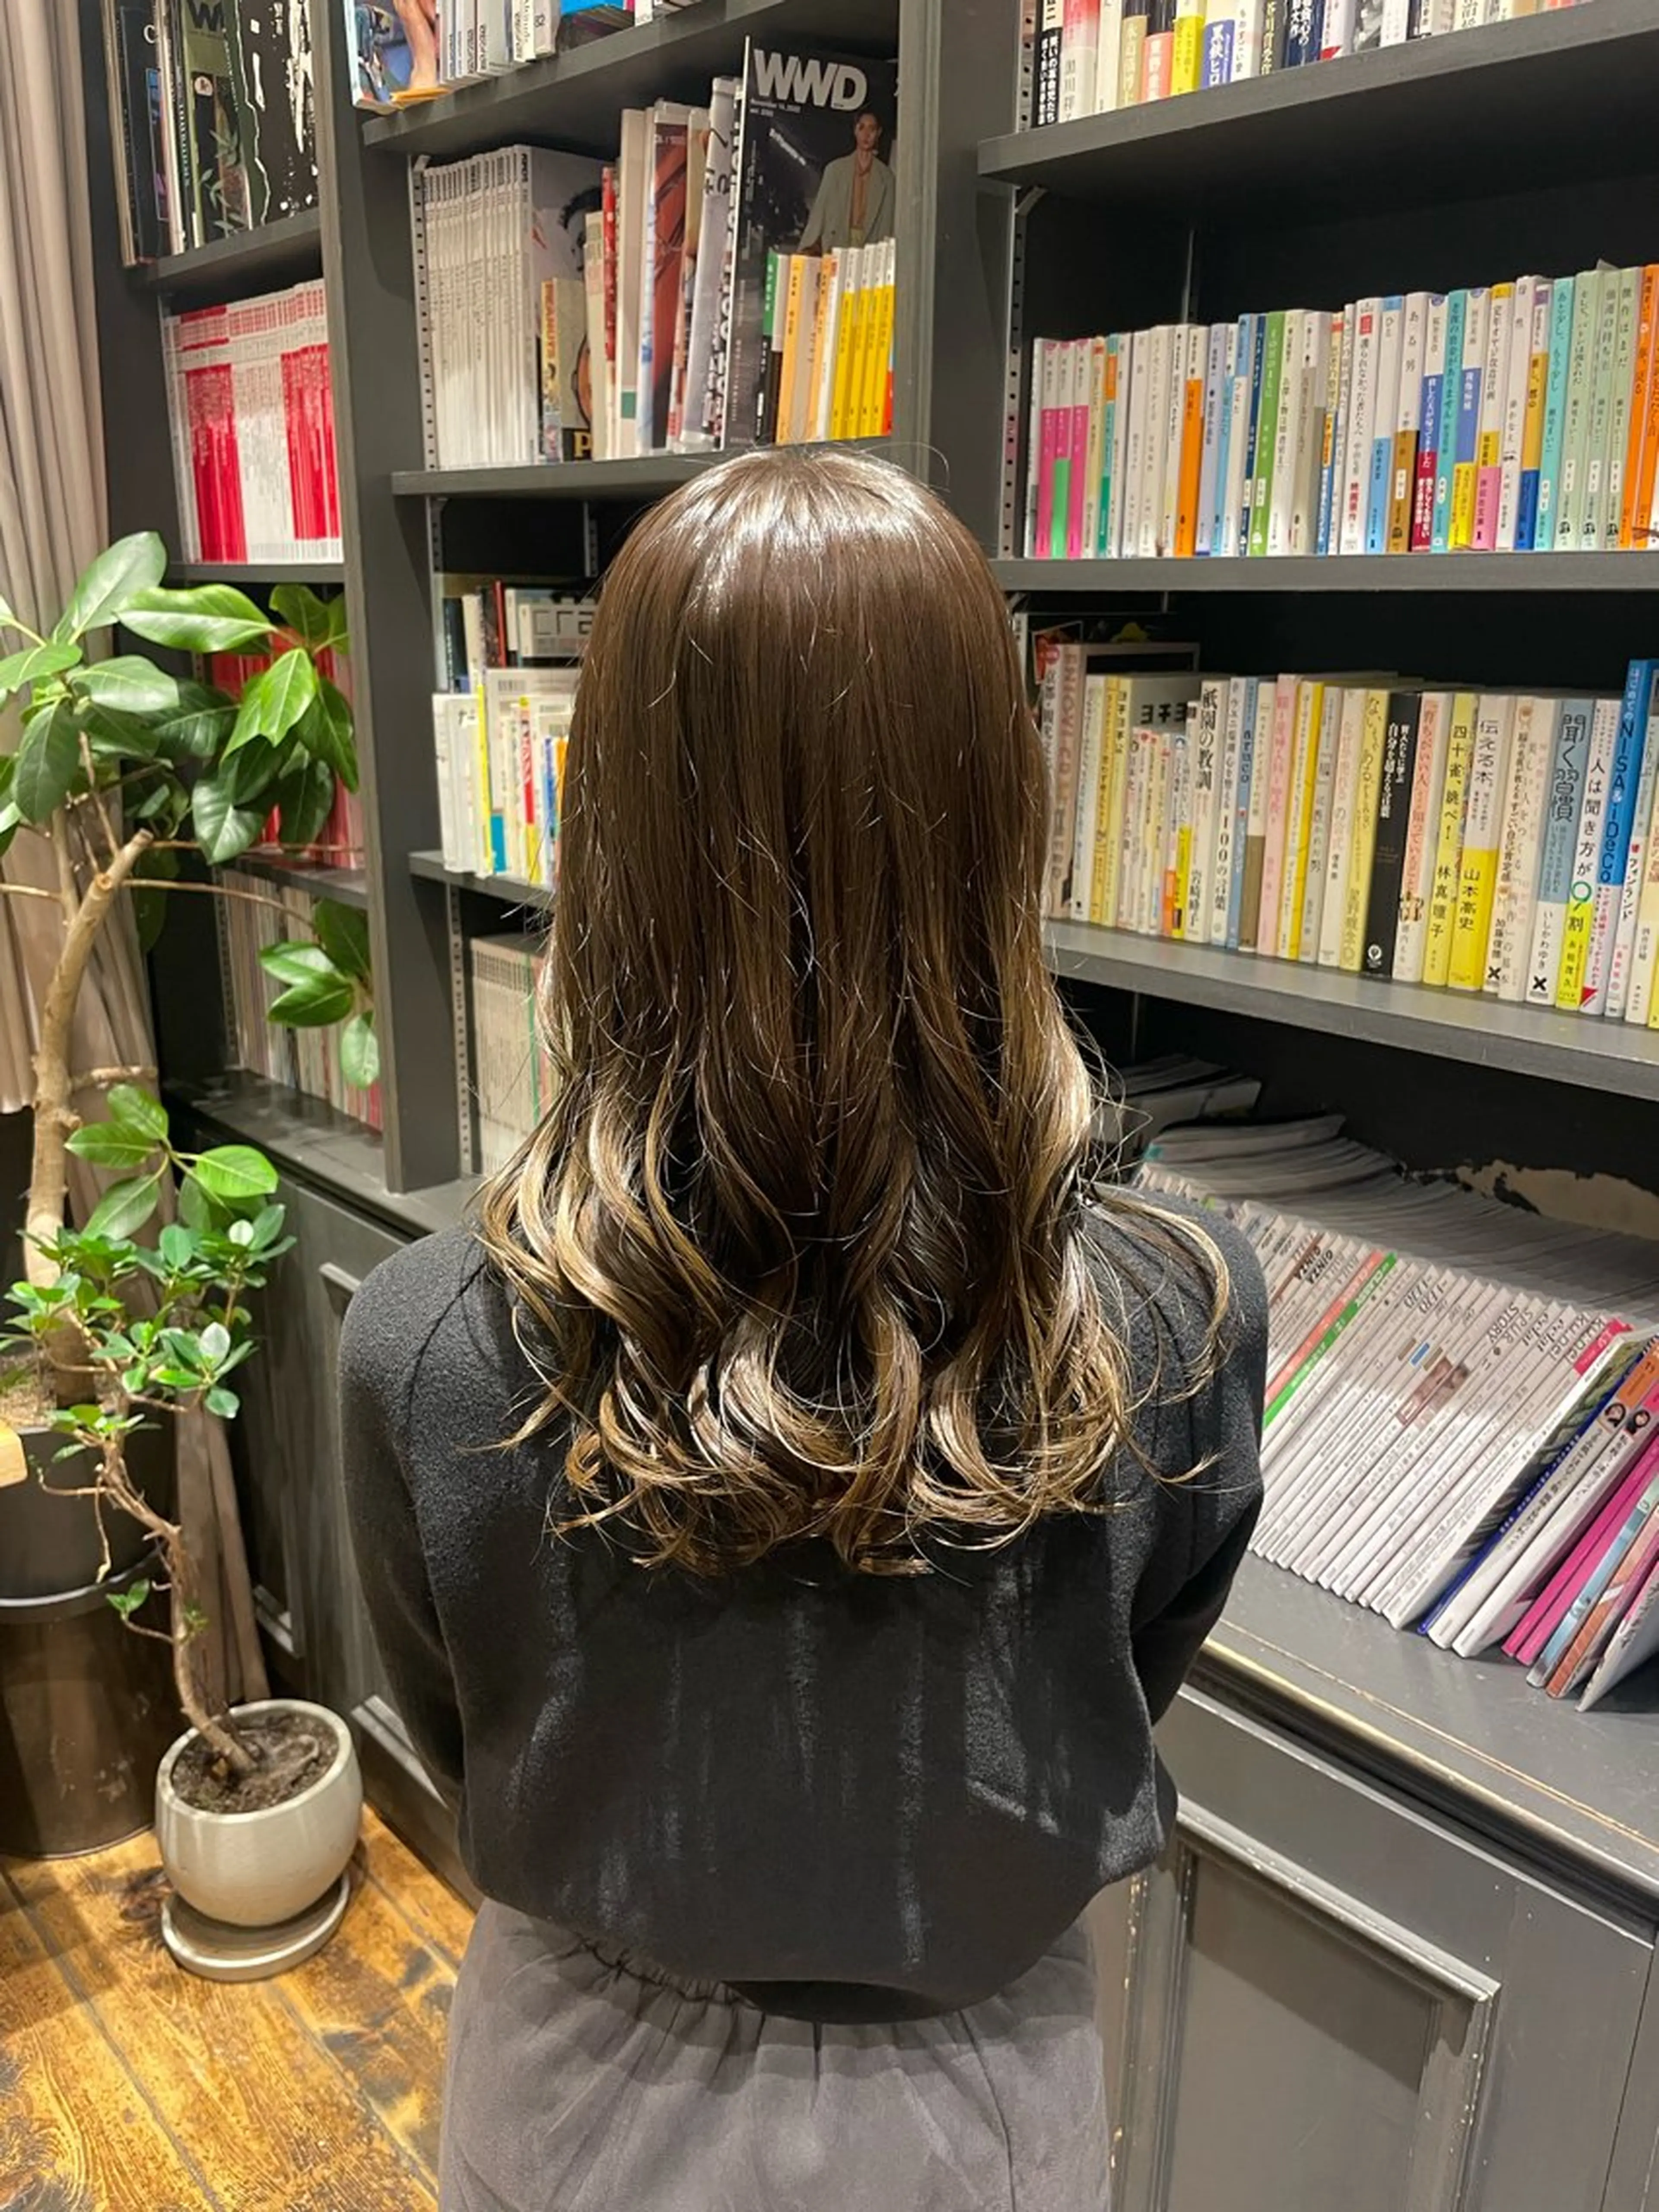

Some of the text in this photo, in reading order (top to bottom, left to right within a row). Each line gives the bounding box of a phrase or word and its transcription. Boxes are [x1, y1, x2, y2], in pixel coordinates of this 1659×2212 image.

[753, 48, 867, 111] WWD
[1551, 713, 1586, 823] 聞く習慣
[1459, 868, 1481, 931] 山本高史
[1306, 1249, 1334, 1284] GINZA
[1488, 1302, 1519, 1343] STORY
[1501, 1307, 1534, 1344] SPUR
